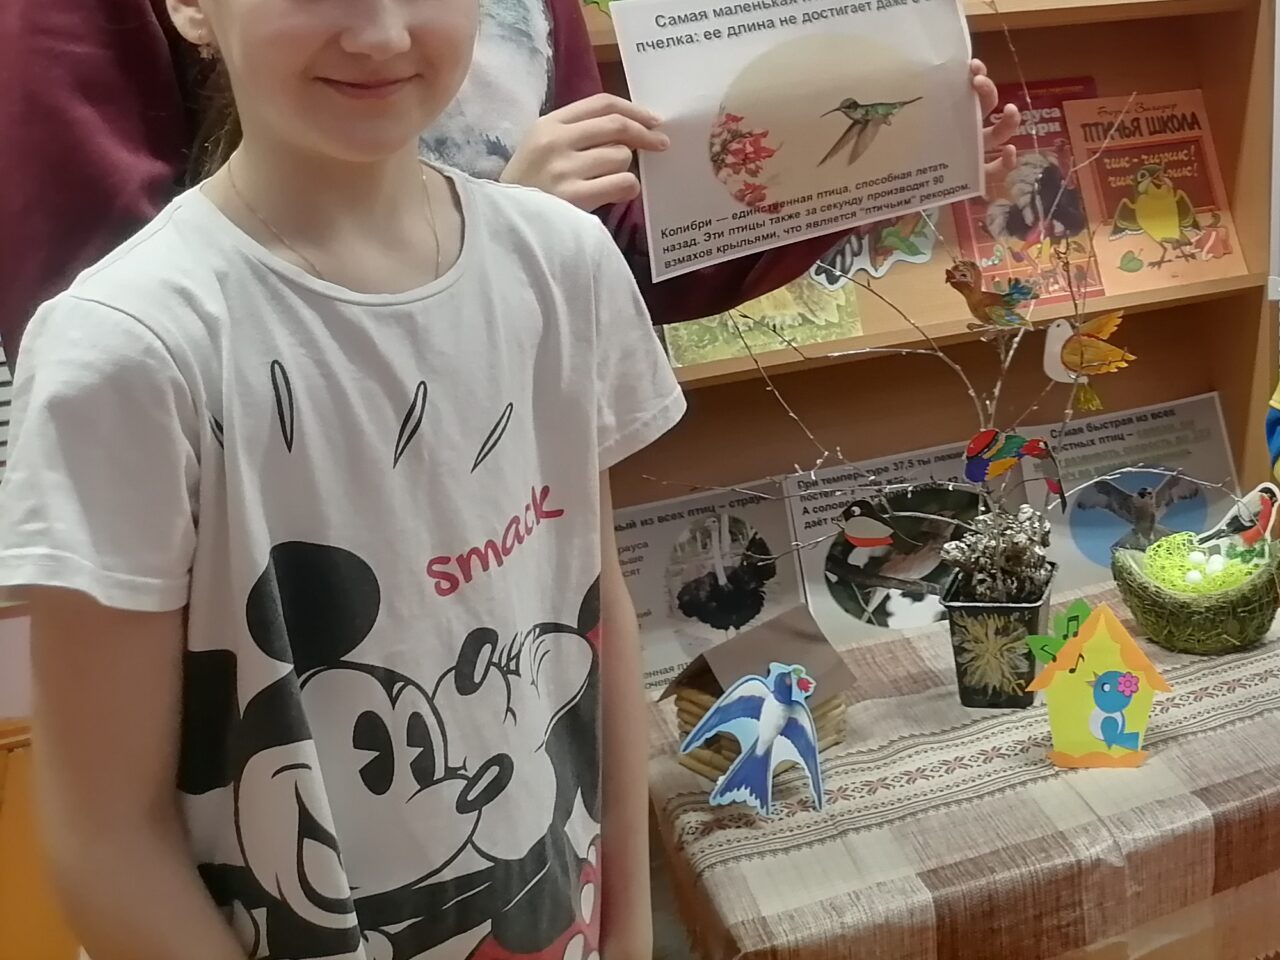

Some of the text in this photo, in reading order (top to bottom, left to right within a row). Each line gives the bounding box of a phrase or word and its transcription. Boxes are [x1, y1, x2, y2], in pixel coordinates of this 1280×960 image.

[634, 30, 701, 53] пчелка:
[703, 27, 722, 41] ее
[726, 17, 775, 39] длина
[779, 13, 798, 27] не
[801, 0, 872, 25] достигает
[654, 8, 708, 29] Самая
[1145, 111, 1202, 137] ШКОЛА
[660, 161, 949, 240] Колибри единственная птица, способная летать
[662, 174, 945, 254] назад. Эти птицы также за секунду производят 90
[664, 247, 713, 269] взмахов
[716, 231, 780, 254] крыльями,
[782, 223, 802, 236] что
[805, 210, 857, 230] является
[919, 182, 971, 204] рекордом.
[1086, 416, 1134, 432] быстрая
[1135, 413, 1148, 423] из
[1150, 408, 1176, 421] всех
[1098, 433, 1126, 445] птиц
[797, 475, 819, 490] При
[892, 459, 914, 472] 37,5
[640, 518, 655, 529] из
[657, 511, 685, 524] всех
[687, 504, 716, 518] птиц
[802, 506, 810, 516] А
[426, 484, 565, 597] smack
[618, 541, 649, 555] рауса
